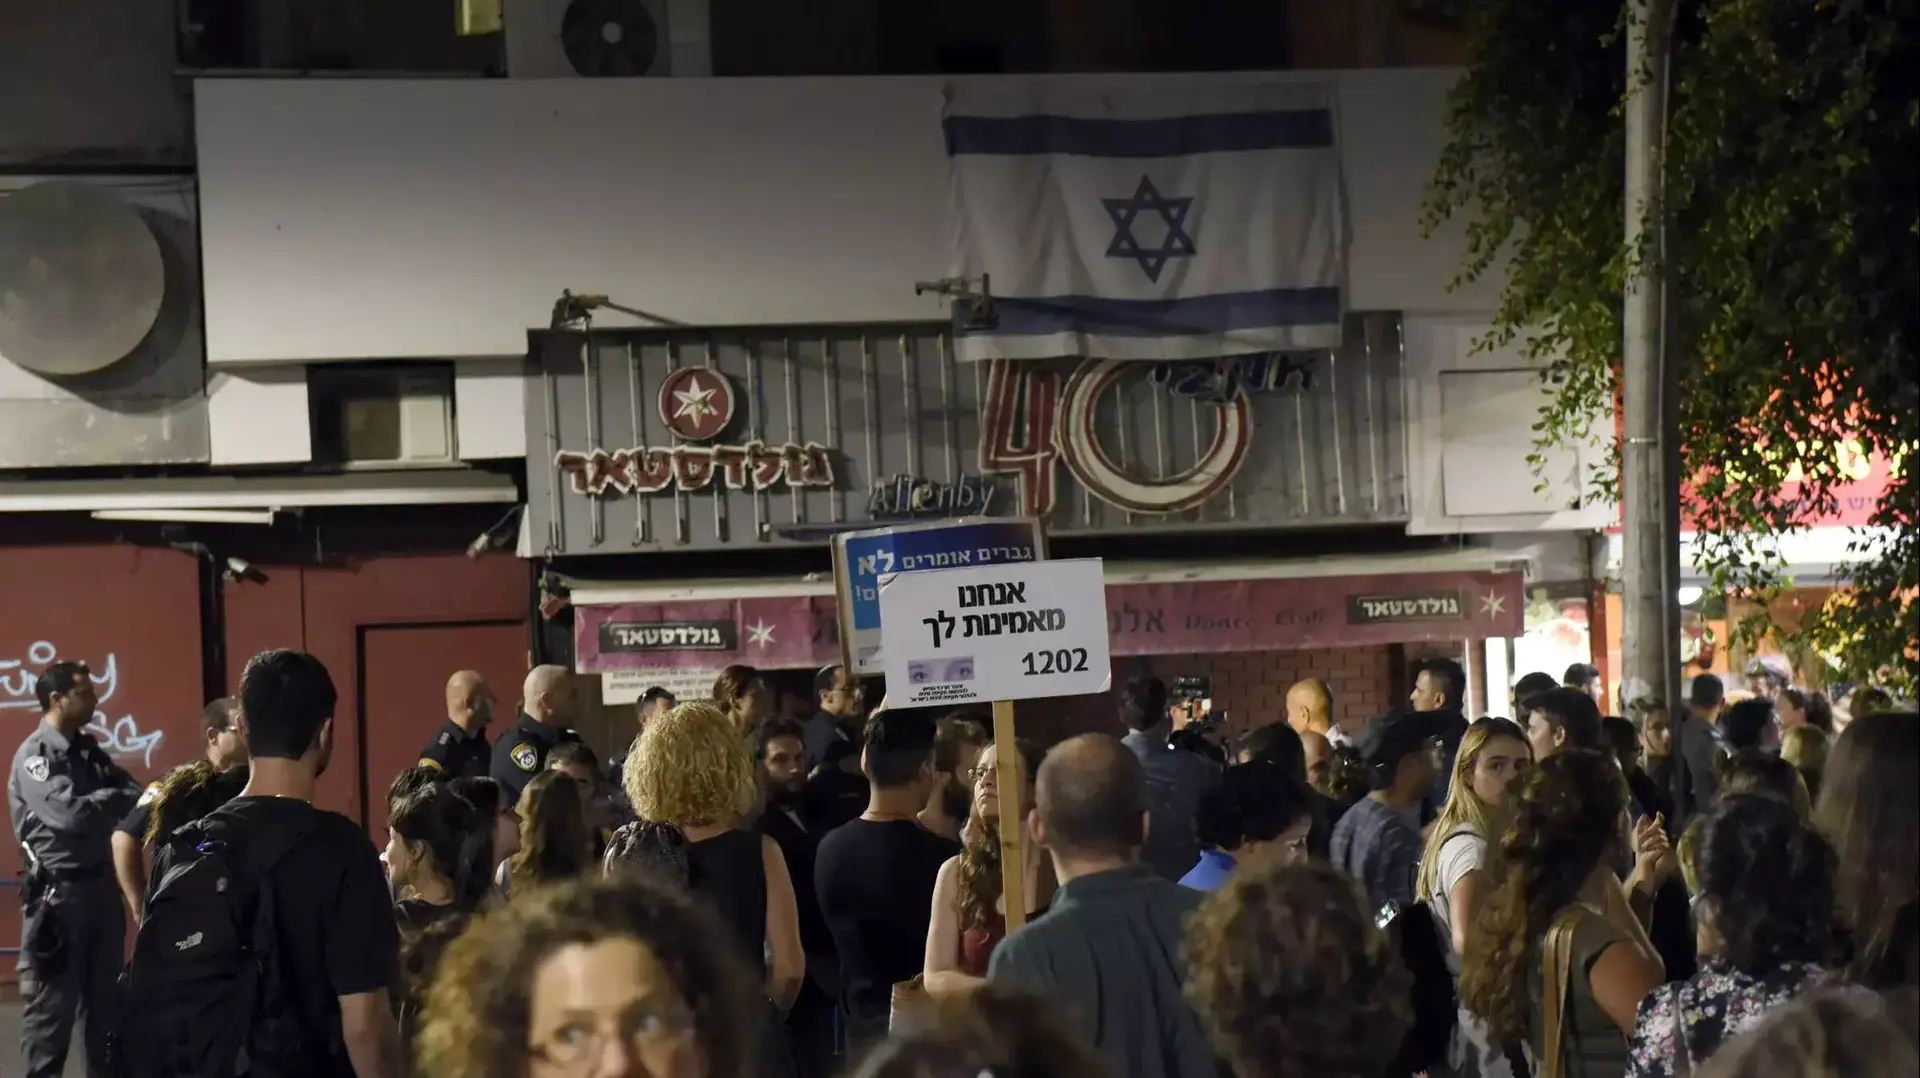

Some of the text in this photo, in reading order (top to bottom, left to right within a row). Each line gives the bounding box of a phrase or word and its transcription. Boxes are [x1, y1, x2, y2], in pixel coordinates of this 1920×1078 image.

[978, 358, 1253, 516] 40
[554, 440, 834, 494] גולדסטאר
[865, 471, 995, 518] Allenby
[858, 545, 1033, 576] גברים אומרים לא
[957, 581, 1026, 608] אנחנו
[1362, 598, 1459, 618] גולדסטאר
[616, 626, 721, 647] גולדסטאר
[922, 608, 1066, 648] מאמינות לך
[1021, 647, 1089, 676] 1202
